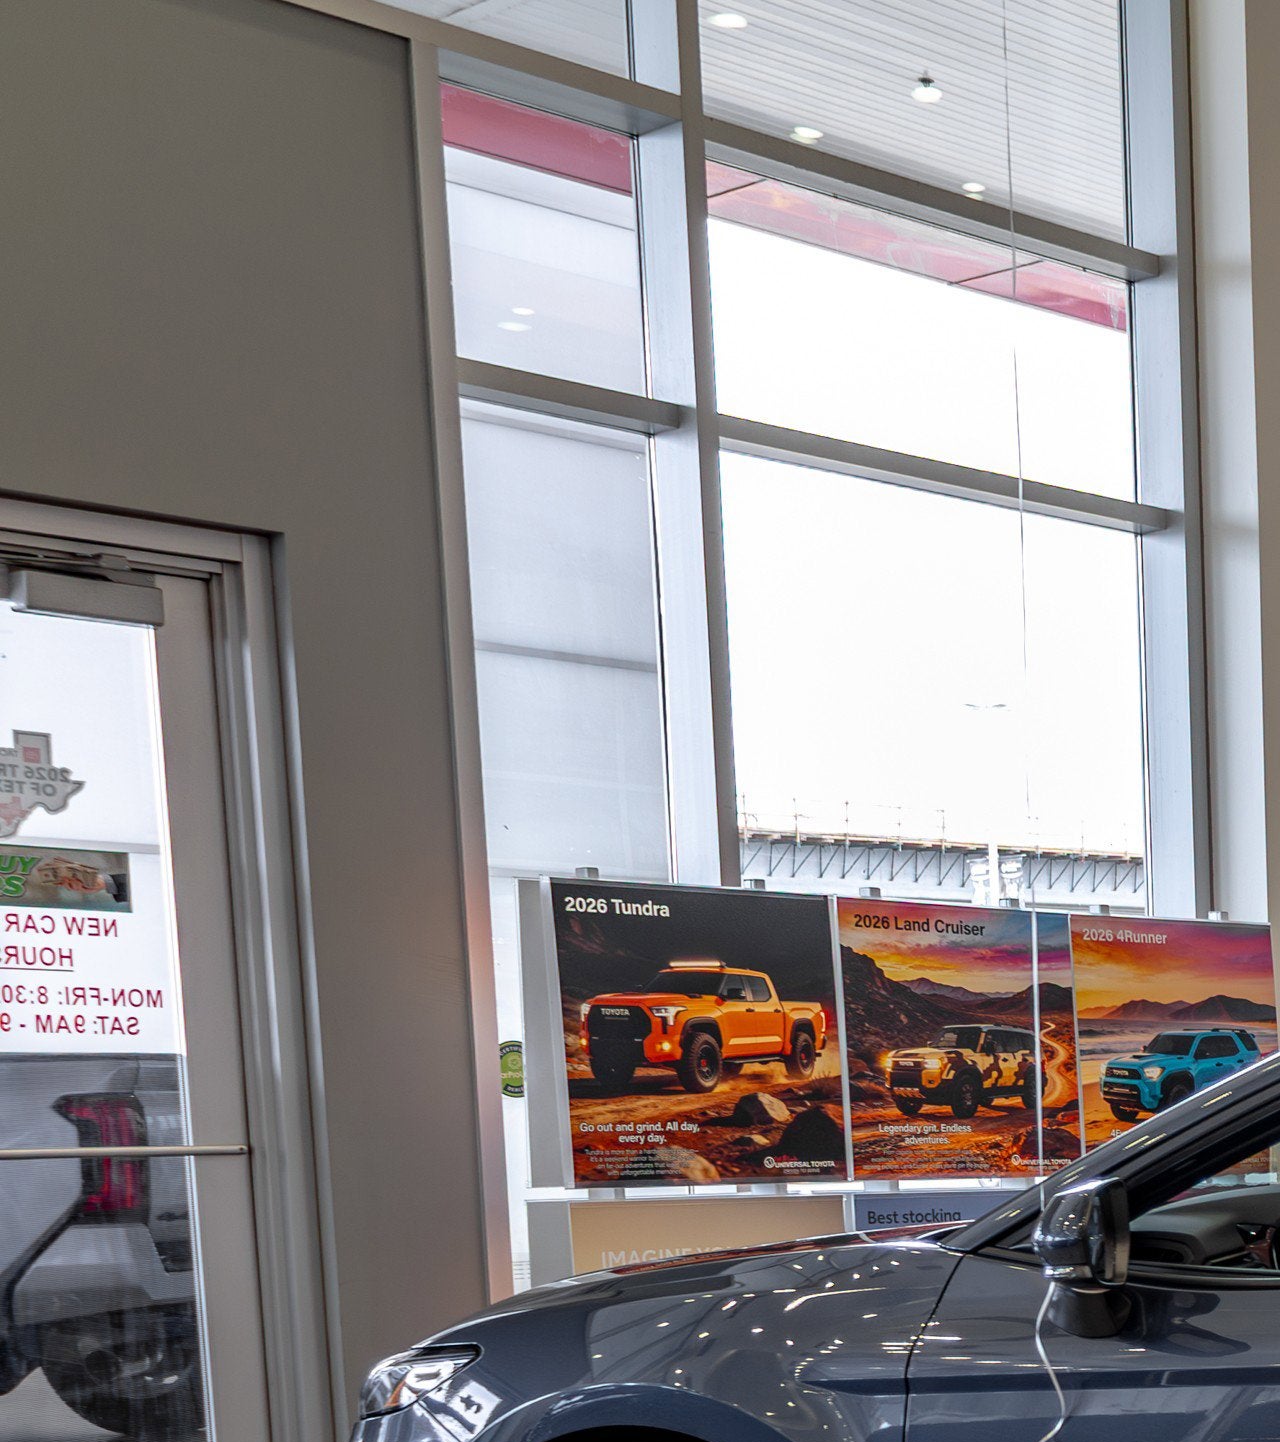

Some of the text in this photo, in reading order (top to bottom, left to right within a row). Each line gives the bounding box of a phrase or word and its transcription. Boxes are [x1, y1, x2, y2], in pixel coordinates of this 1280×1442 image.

[564, 896, 670, 917] 2026 Tundra
[853, 914, 985, 937] 2026 Land Cruiser
[1082, 927, 1168, 945] 2026 4Runner
[600, 1007, 630, 1016] TOYOTA
[579, 1121, 700, 1133] Go out and grind. All day,
[878, 1123, 972, 1134] Legendary grit. Endless
[618, 1133, 667, 1145] every day.
[904, 1136, 951, 1145] adventures.
[774, 1160, 836, 1168] UNIVERSAL TOYOTA
[868, 1211, 900, 1225] Best
